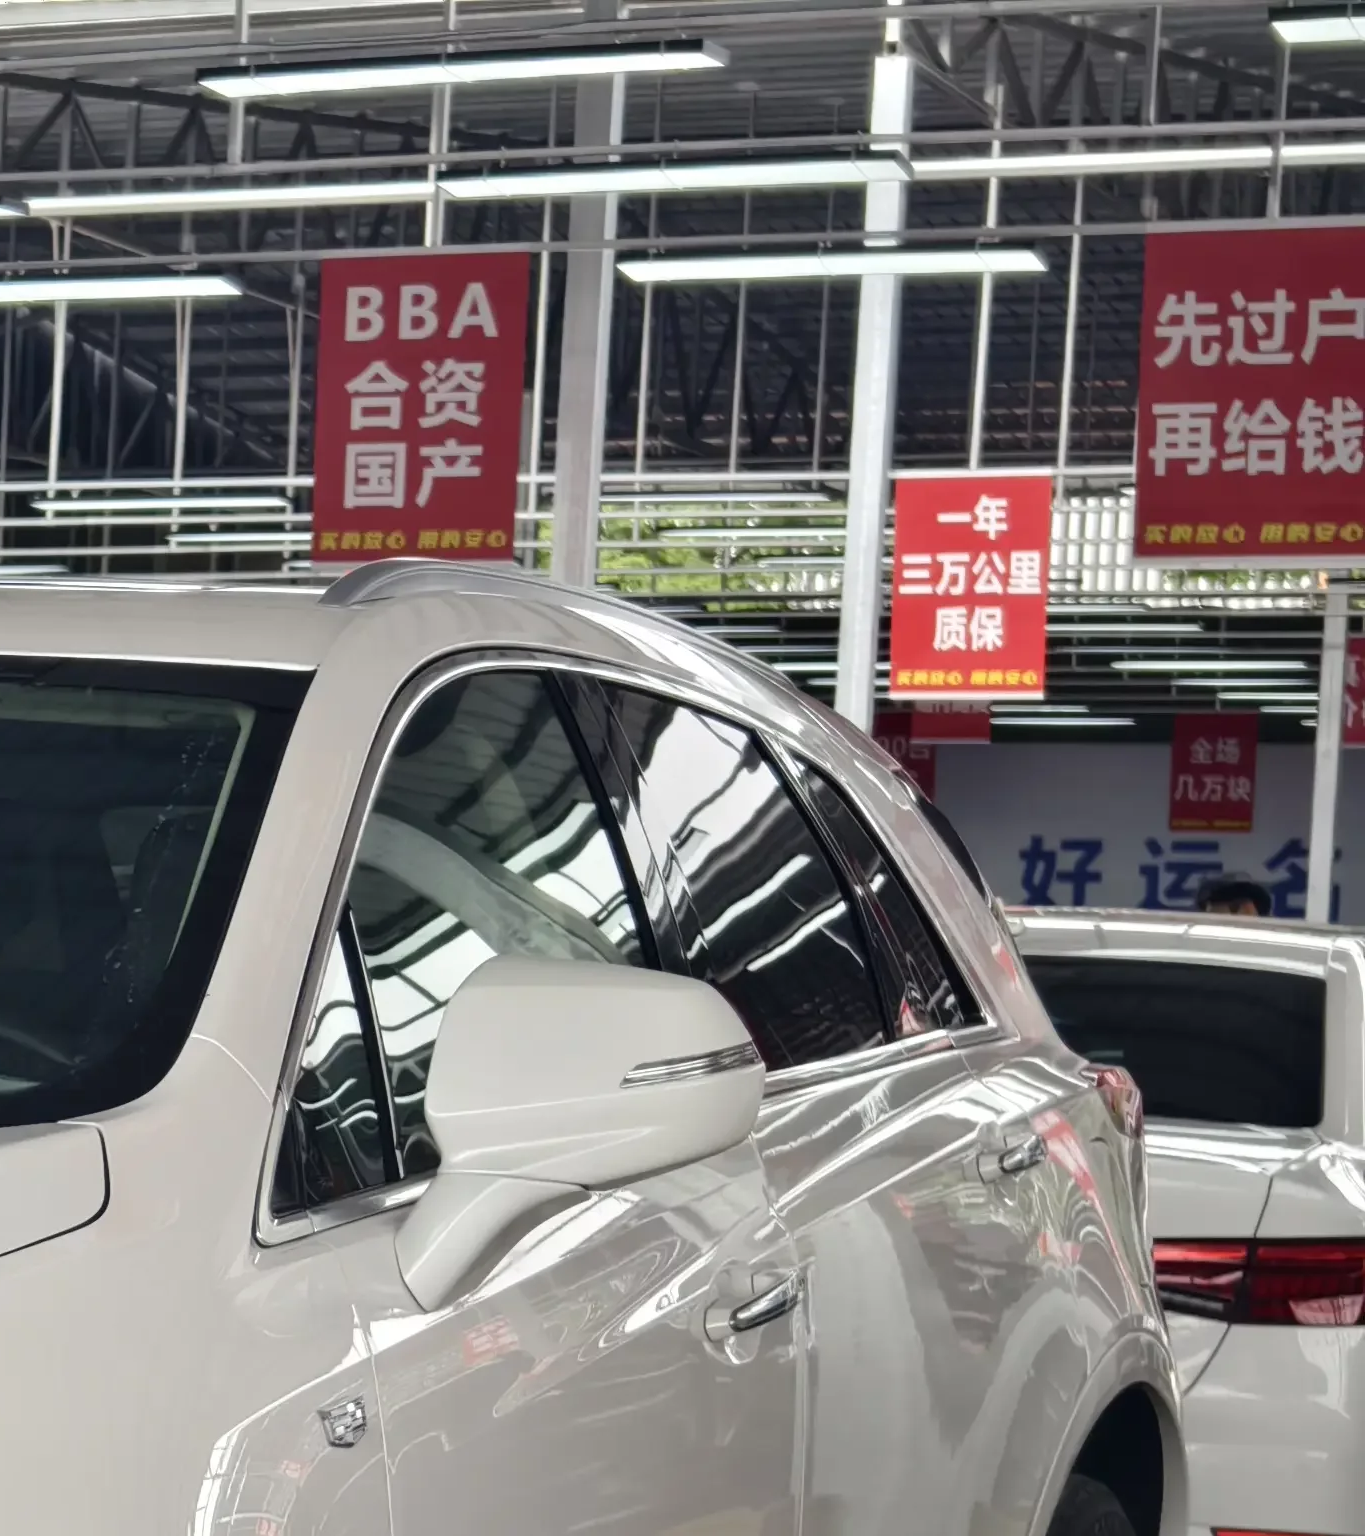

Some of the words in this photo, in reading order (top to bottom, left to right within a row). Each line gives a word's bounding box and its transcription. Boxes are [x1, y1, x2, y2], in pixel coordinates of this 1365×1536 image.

[344, 282, 498, 342] BBA
[1153, 288, 1365, 369] 先过户
[344, 358, 485, 431] 合资
[1148, 396, 1365, 477] 再给钱
[344, 438, 483, 509] 国产
[936, 494, 1009, 541] 一年
[898, 550, 1042, 596] 三万公里
[932, 606, 1004, 652] 质保
